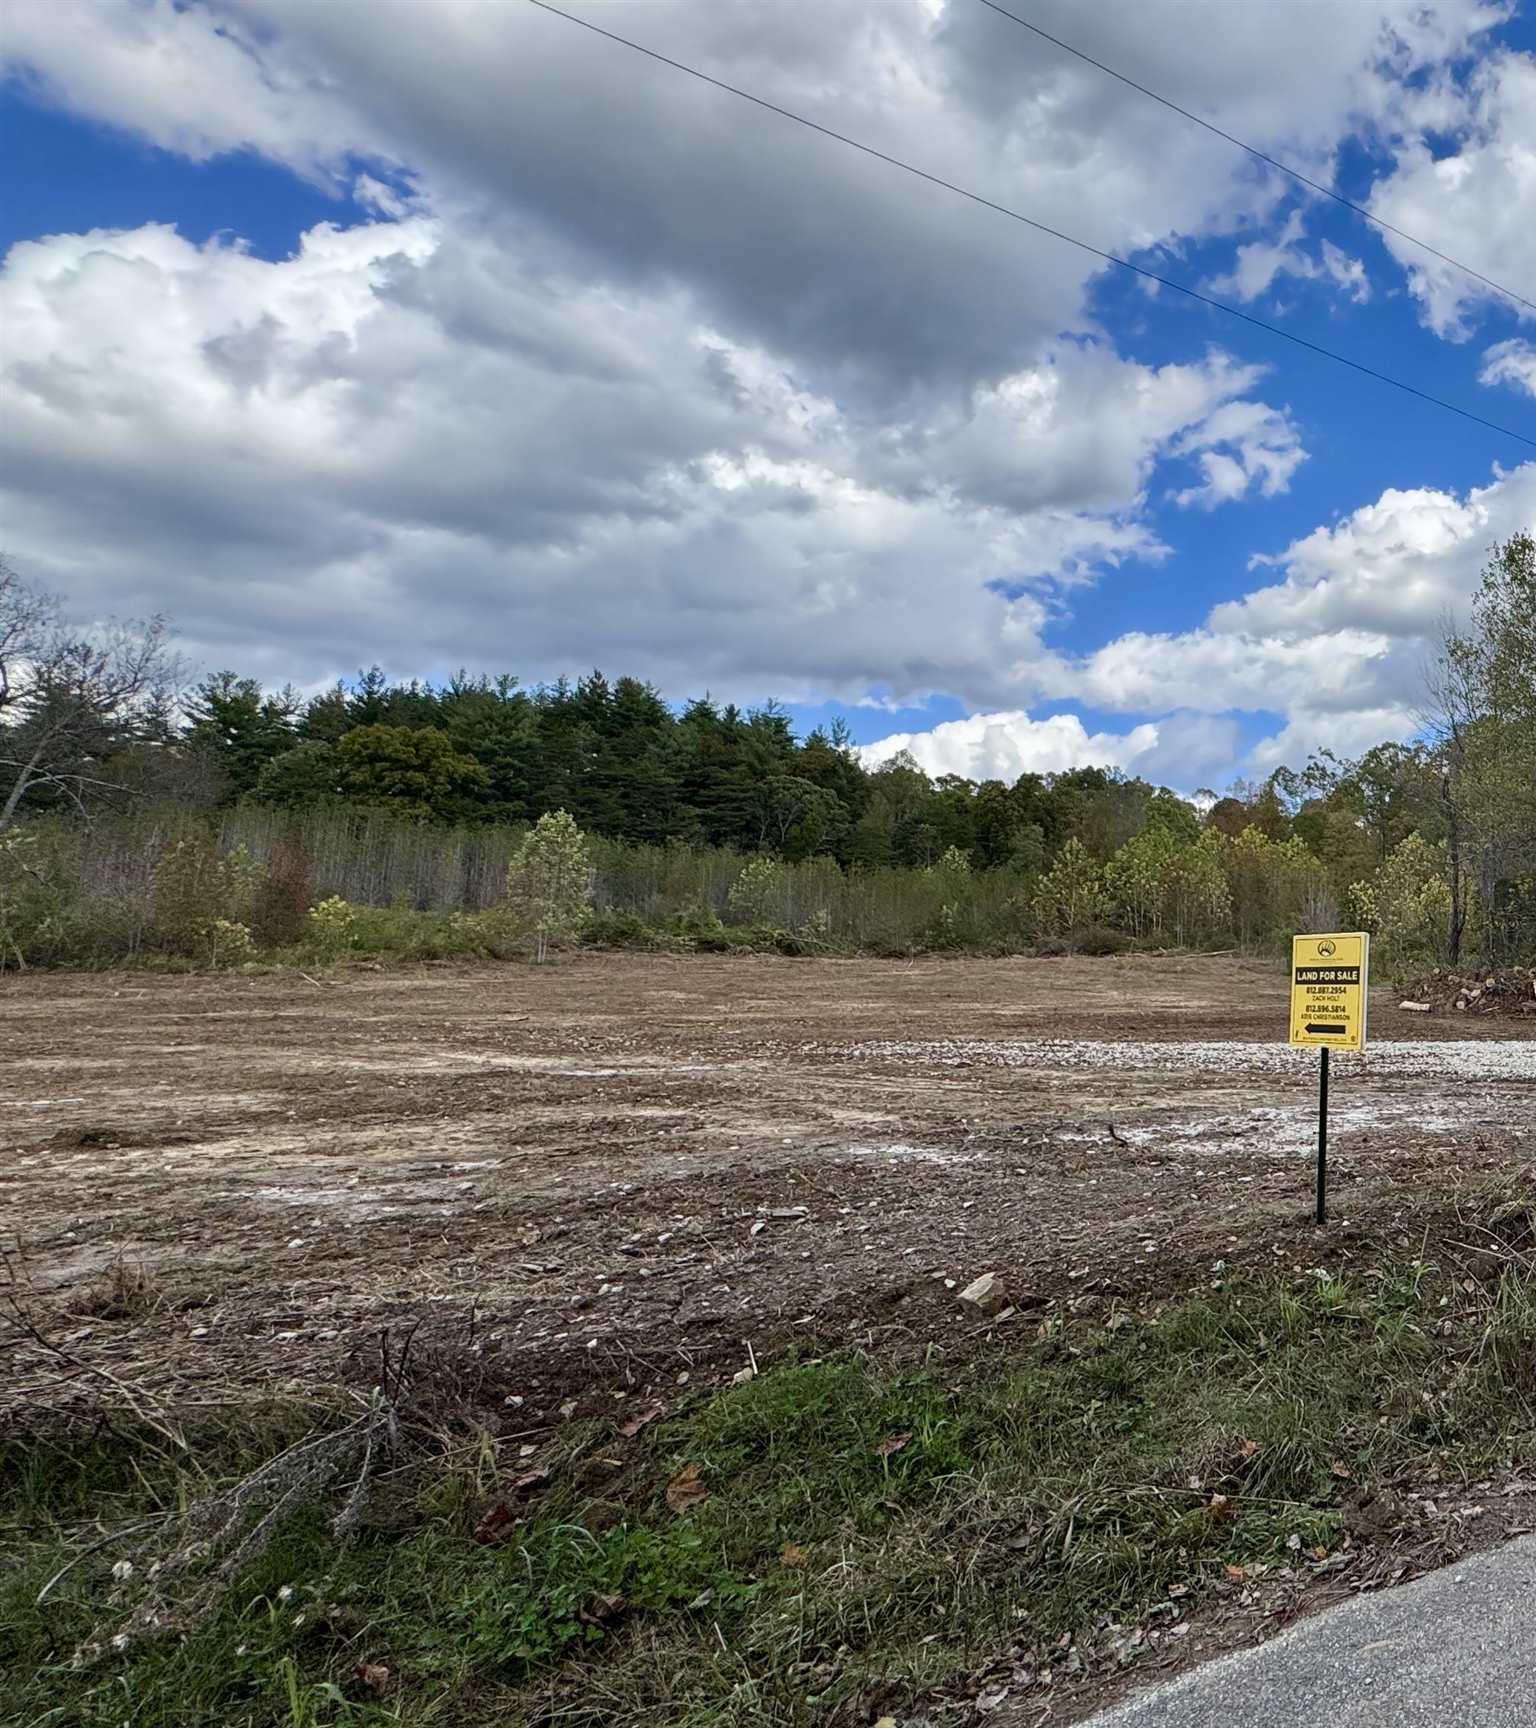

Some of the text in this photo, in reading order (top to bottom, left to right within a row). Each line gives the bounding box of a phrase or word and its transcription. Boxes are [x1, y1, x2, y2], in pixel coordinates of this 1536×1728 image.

[1297, 971, 1358, 981] LAND FOR SALE
